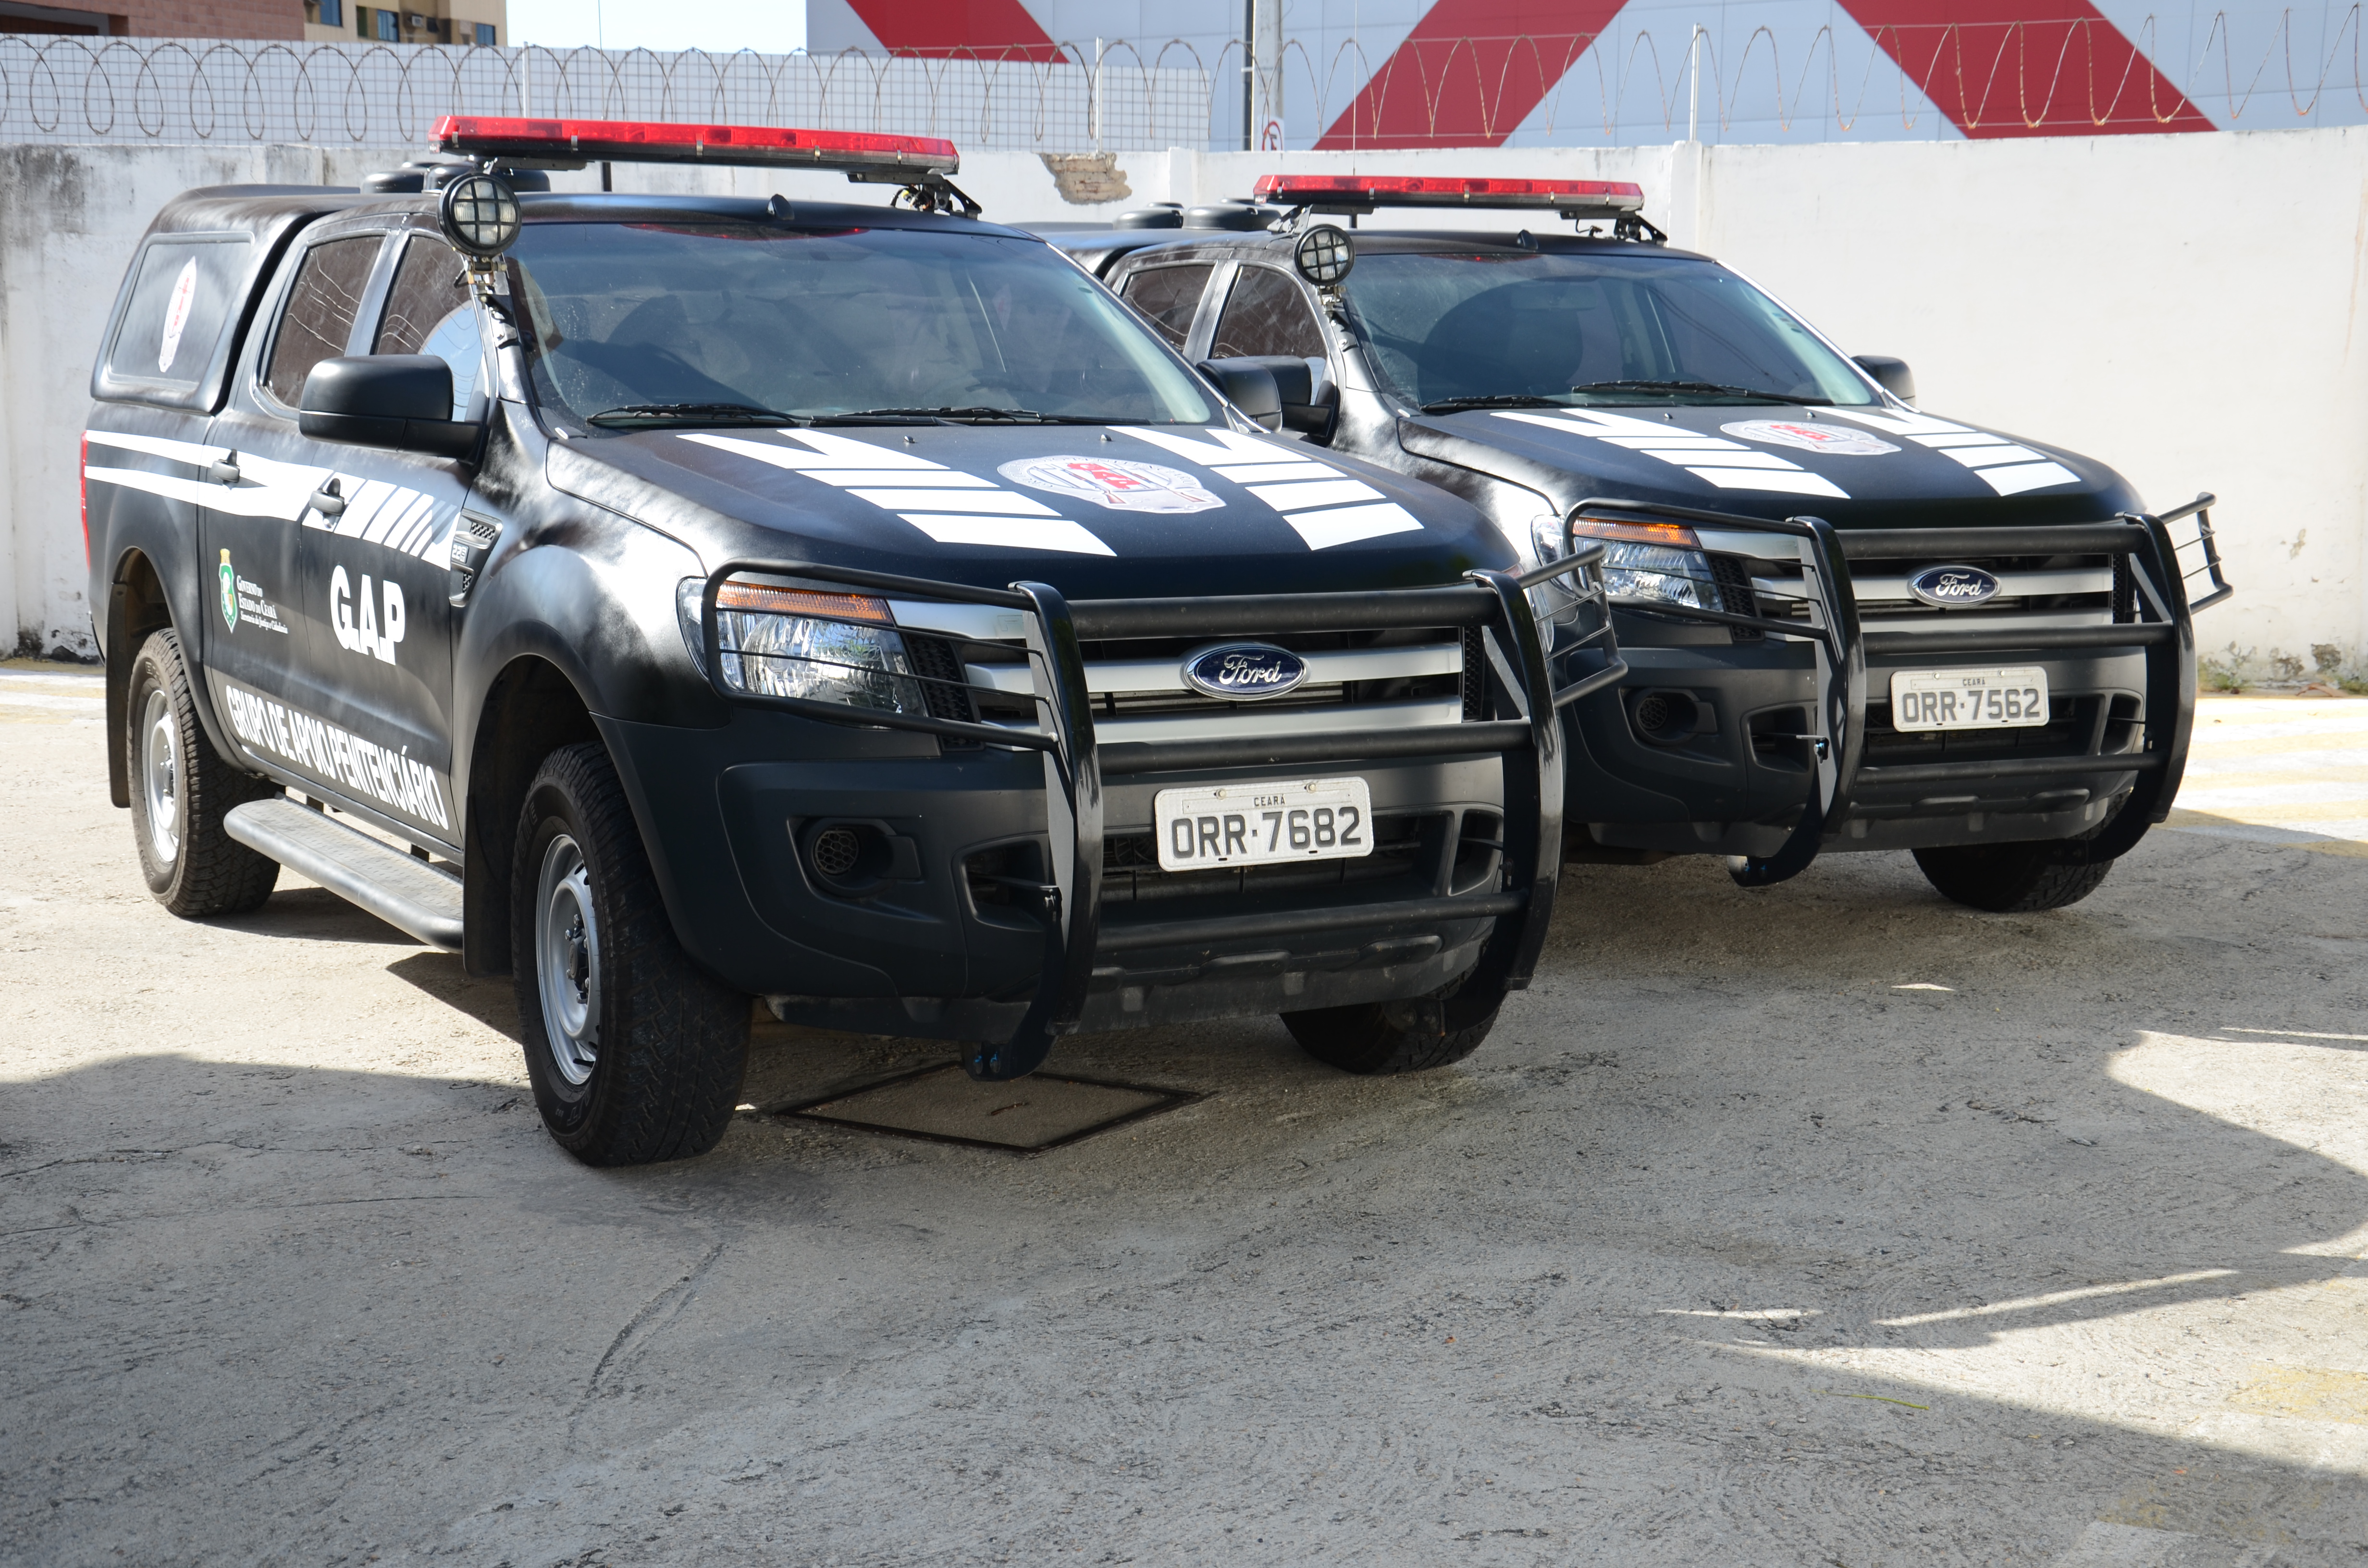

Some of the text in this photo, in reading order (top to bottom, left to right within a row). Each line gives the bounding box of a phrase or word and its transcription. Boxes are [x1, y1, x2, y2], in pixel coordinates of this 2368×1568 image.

[1936, 573, 1982, 596] Ford
[1219, 654, 1283, 685] Ford
[1962, 676, 1986, 686] CEARÁ
[225, 685, 449, 831] GRUPO DE APOIO PENITENCIÁRIO
[1253, 793, 1286, 807] CEARÁ
